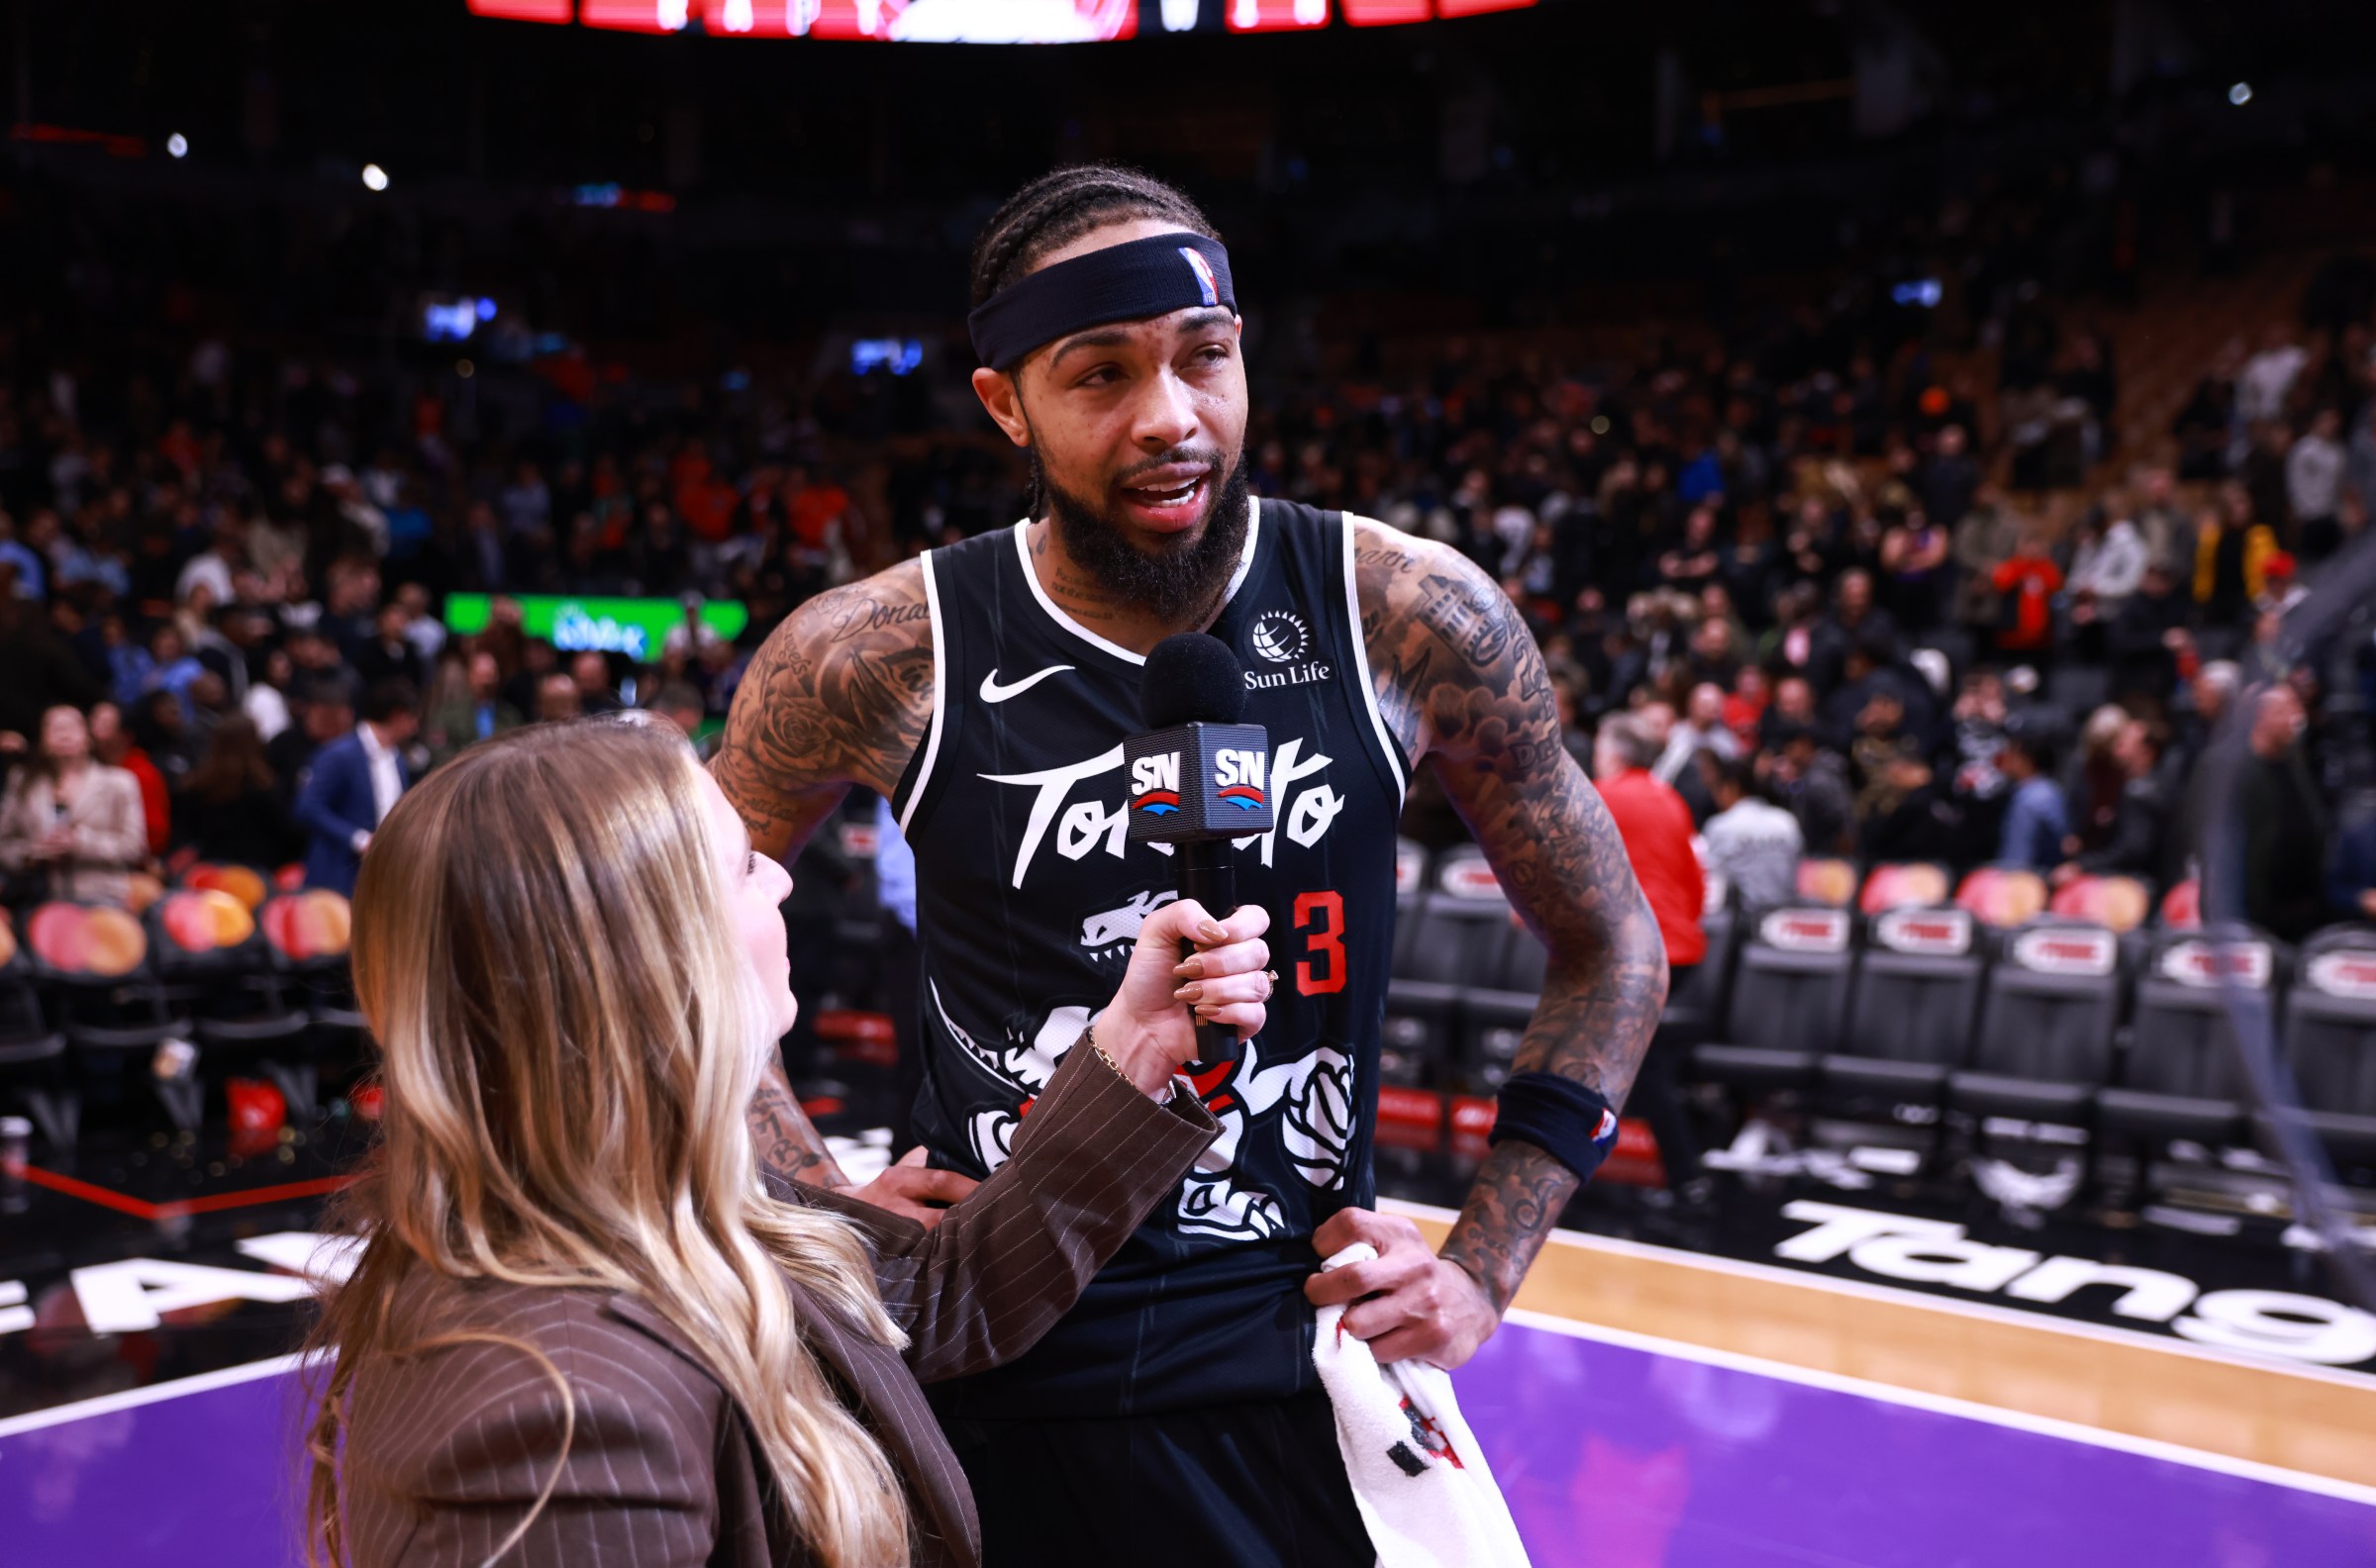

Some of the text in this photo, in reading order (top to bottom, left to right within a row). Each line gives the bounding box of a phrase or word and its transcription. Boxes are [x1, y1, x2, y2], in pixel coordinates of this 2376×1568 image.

[1243, 660, 1332, 690] Sun Life
[1131, 750, 1181, 796] SN
[1214, 748, 1265, 791] SN
[1293, 890, 1346, 997] 3
